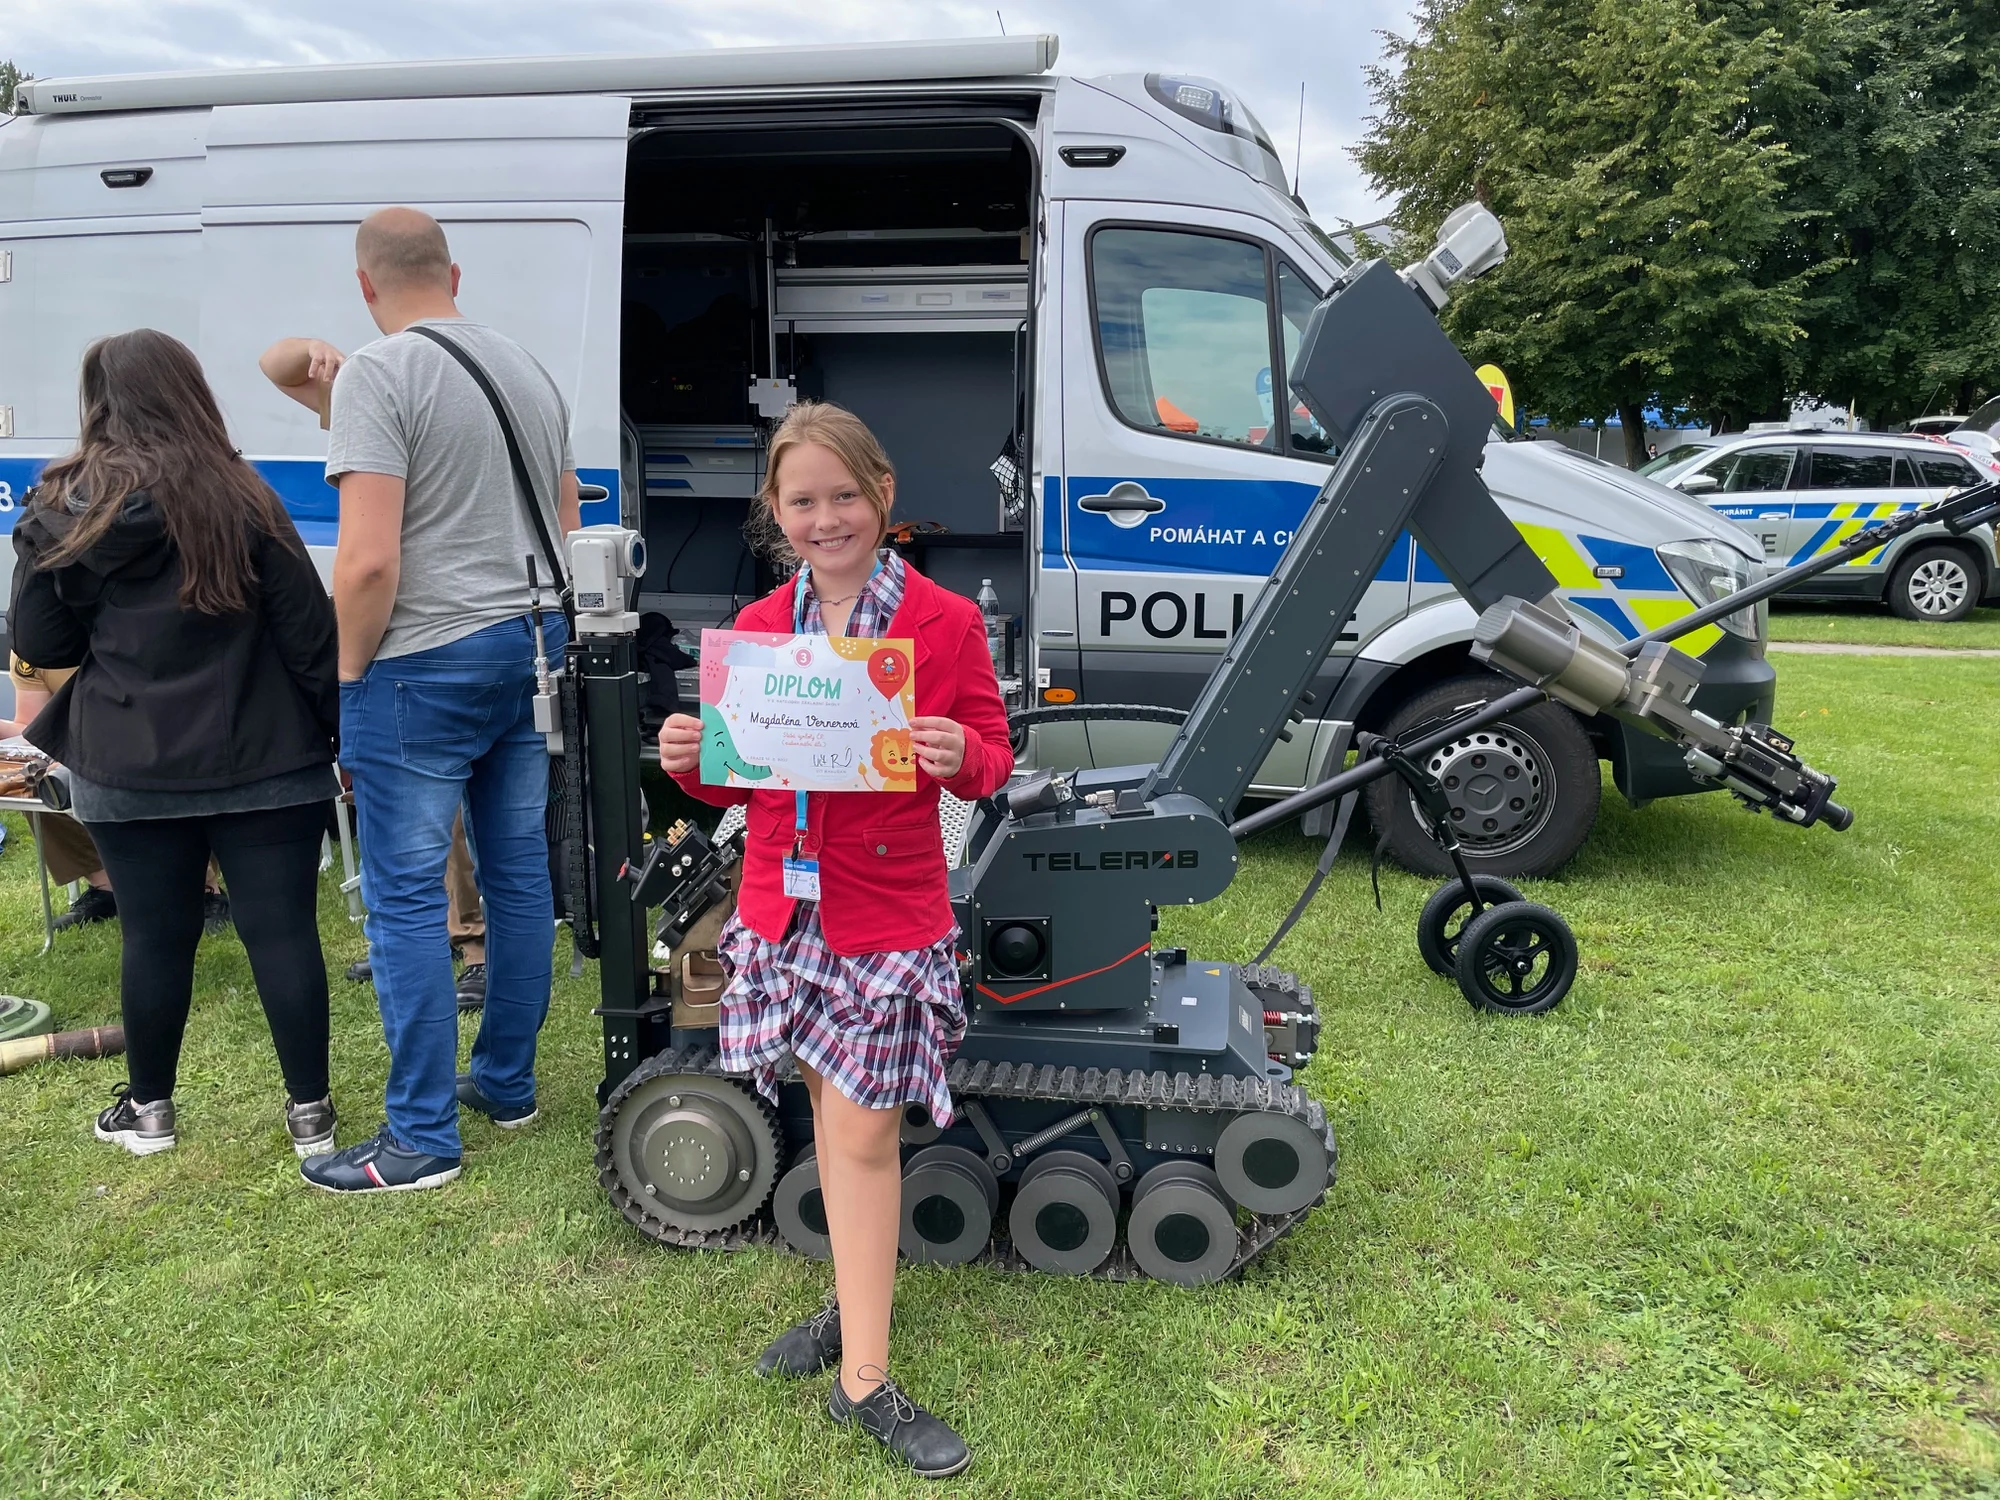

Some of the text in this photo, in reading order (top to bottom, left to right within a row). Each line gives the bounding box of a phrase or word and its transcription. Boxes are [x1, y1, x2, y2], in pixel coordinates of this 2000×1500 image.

[53, 94, 77, 103] THULE
[1150, 525, 1246, 545] POMÁHAT
[1252, 530, 1266, 545] A
[800, 652, 807, 664] 3
[765, 674, 842, 700] DIPLOM
[750, 711, 860, 729] Magdaléna Vernerová
